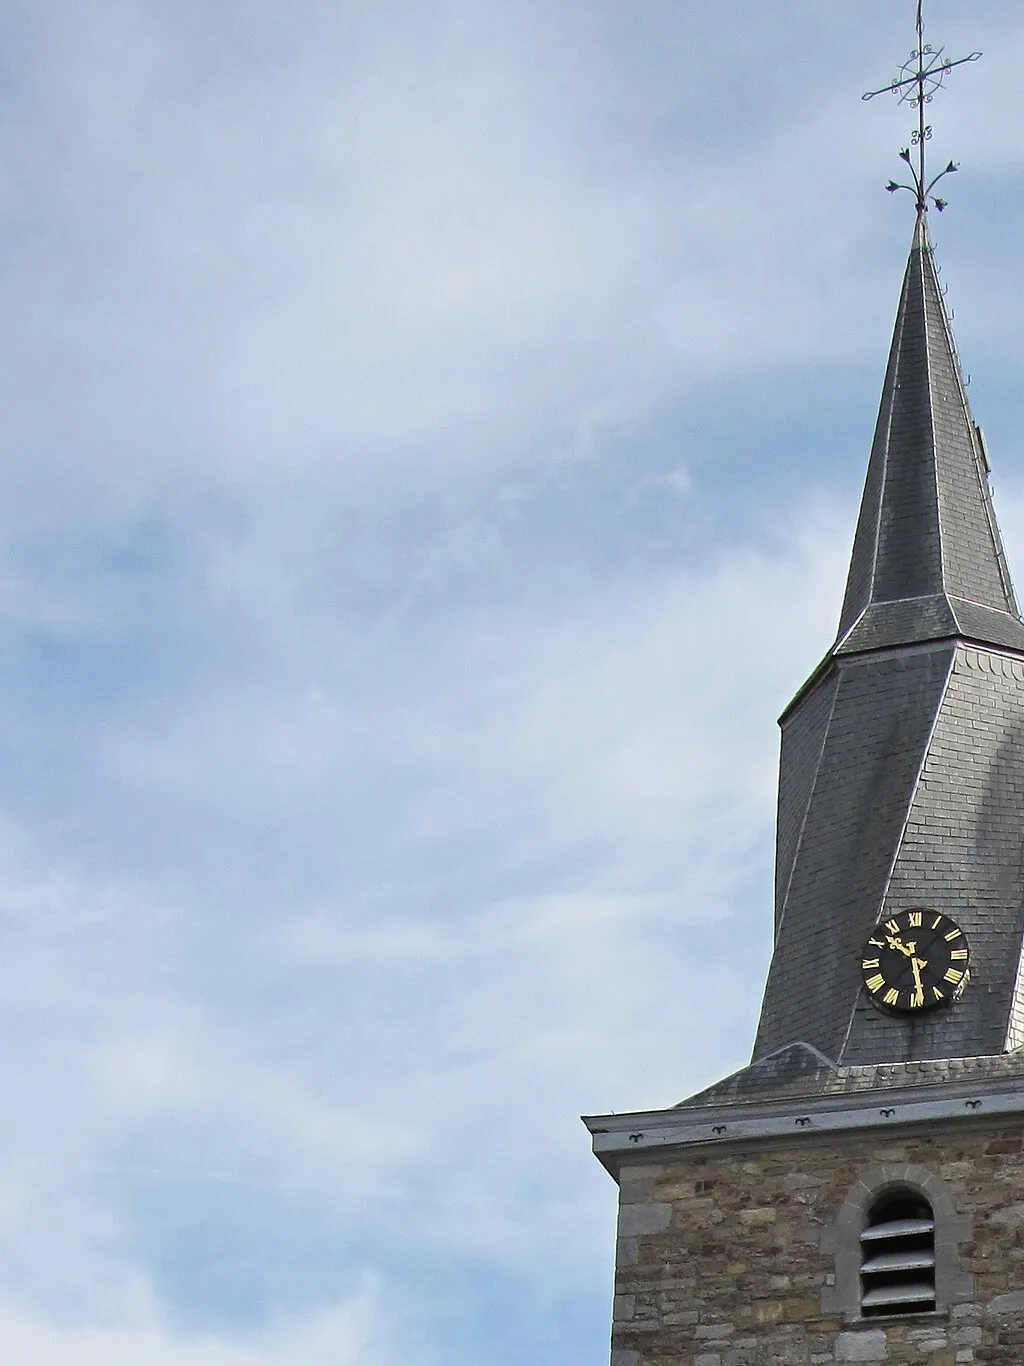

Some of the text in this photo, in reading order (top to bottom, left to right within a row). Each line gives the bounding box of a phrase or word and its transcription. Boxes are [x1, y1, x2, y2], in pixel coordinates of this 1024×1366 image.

[885, 919, 901, 934] XI
[909, 912, 922, 927] XII
[932, 916, 942, 929] I
[944, 928, 962, 942] II
[868, 937, 884, 949] X
[951, 949, 968, 960] III
[862, 958, 880, 969] IX
[866, 973, 885, 994] VIII
[883, 988, 899, 1005] VII
[932, 986, 944, 1000] V
